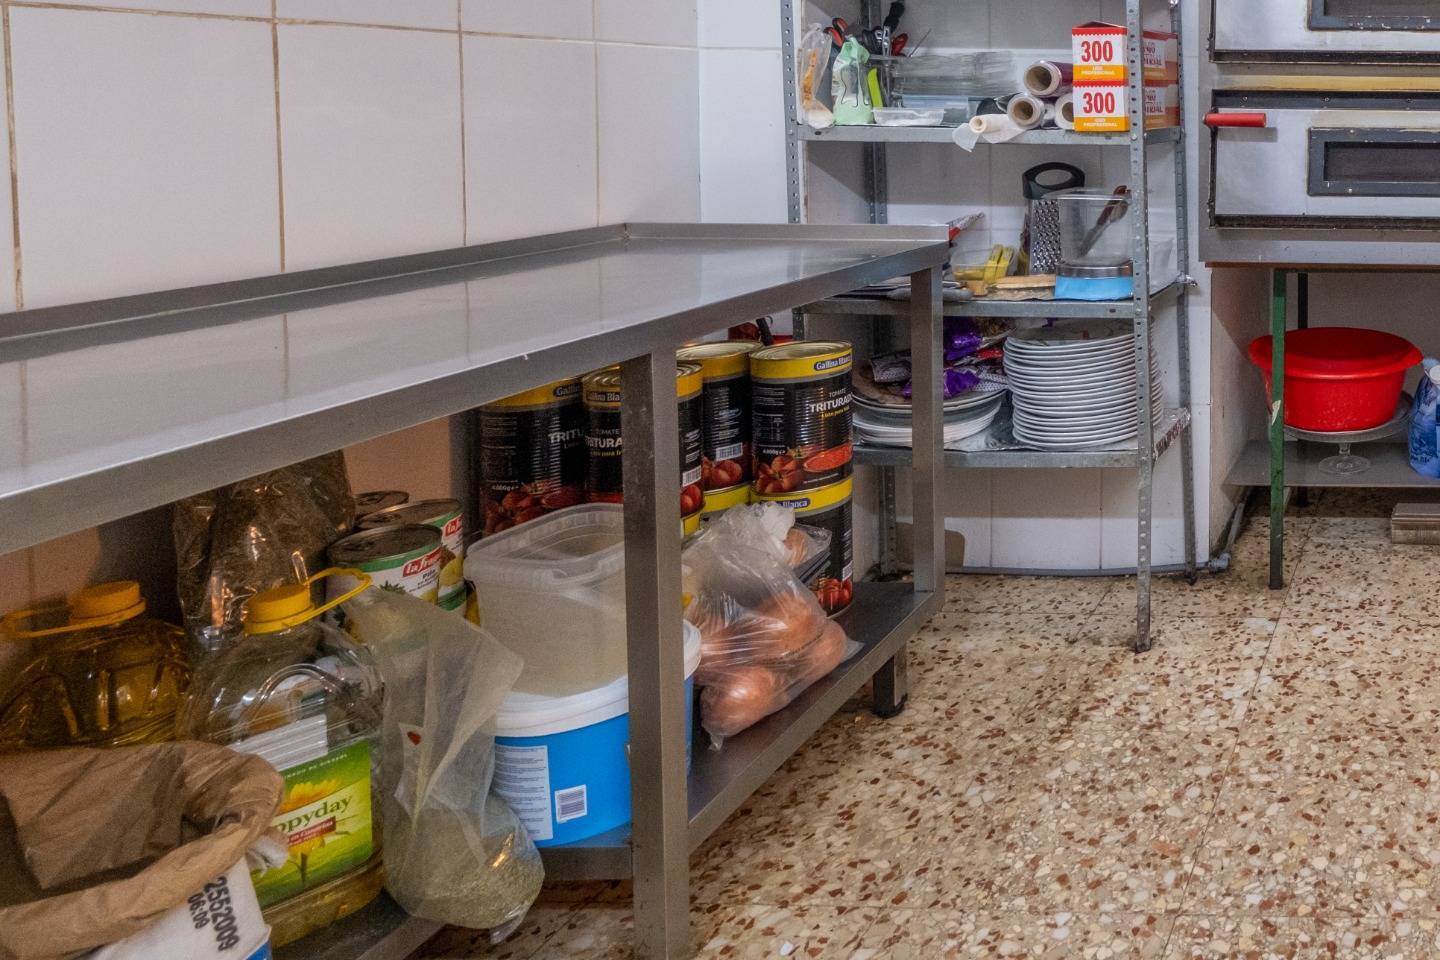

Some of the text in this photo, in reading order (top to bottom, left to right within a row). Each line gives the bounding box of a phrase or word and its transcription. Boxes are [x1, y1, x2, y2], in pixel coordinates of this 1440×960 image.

[1081, 41, 1113, 62] 300
[1083, 92, 1115, 113] 300
[607, 392, 620, 401] Bla
[809, 392, 853, 413] TRITURAD
[548, 429, 583, 444] TRITU
[783, 500, 808, 509] Blanca
[276, 796, 353, 833] ppyday
